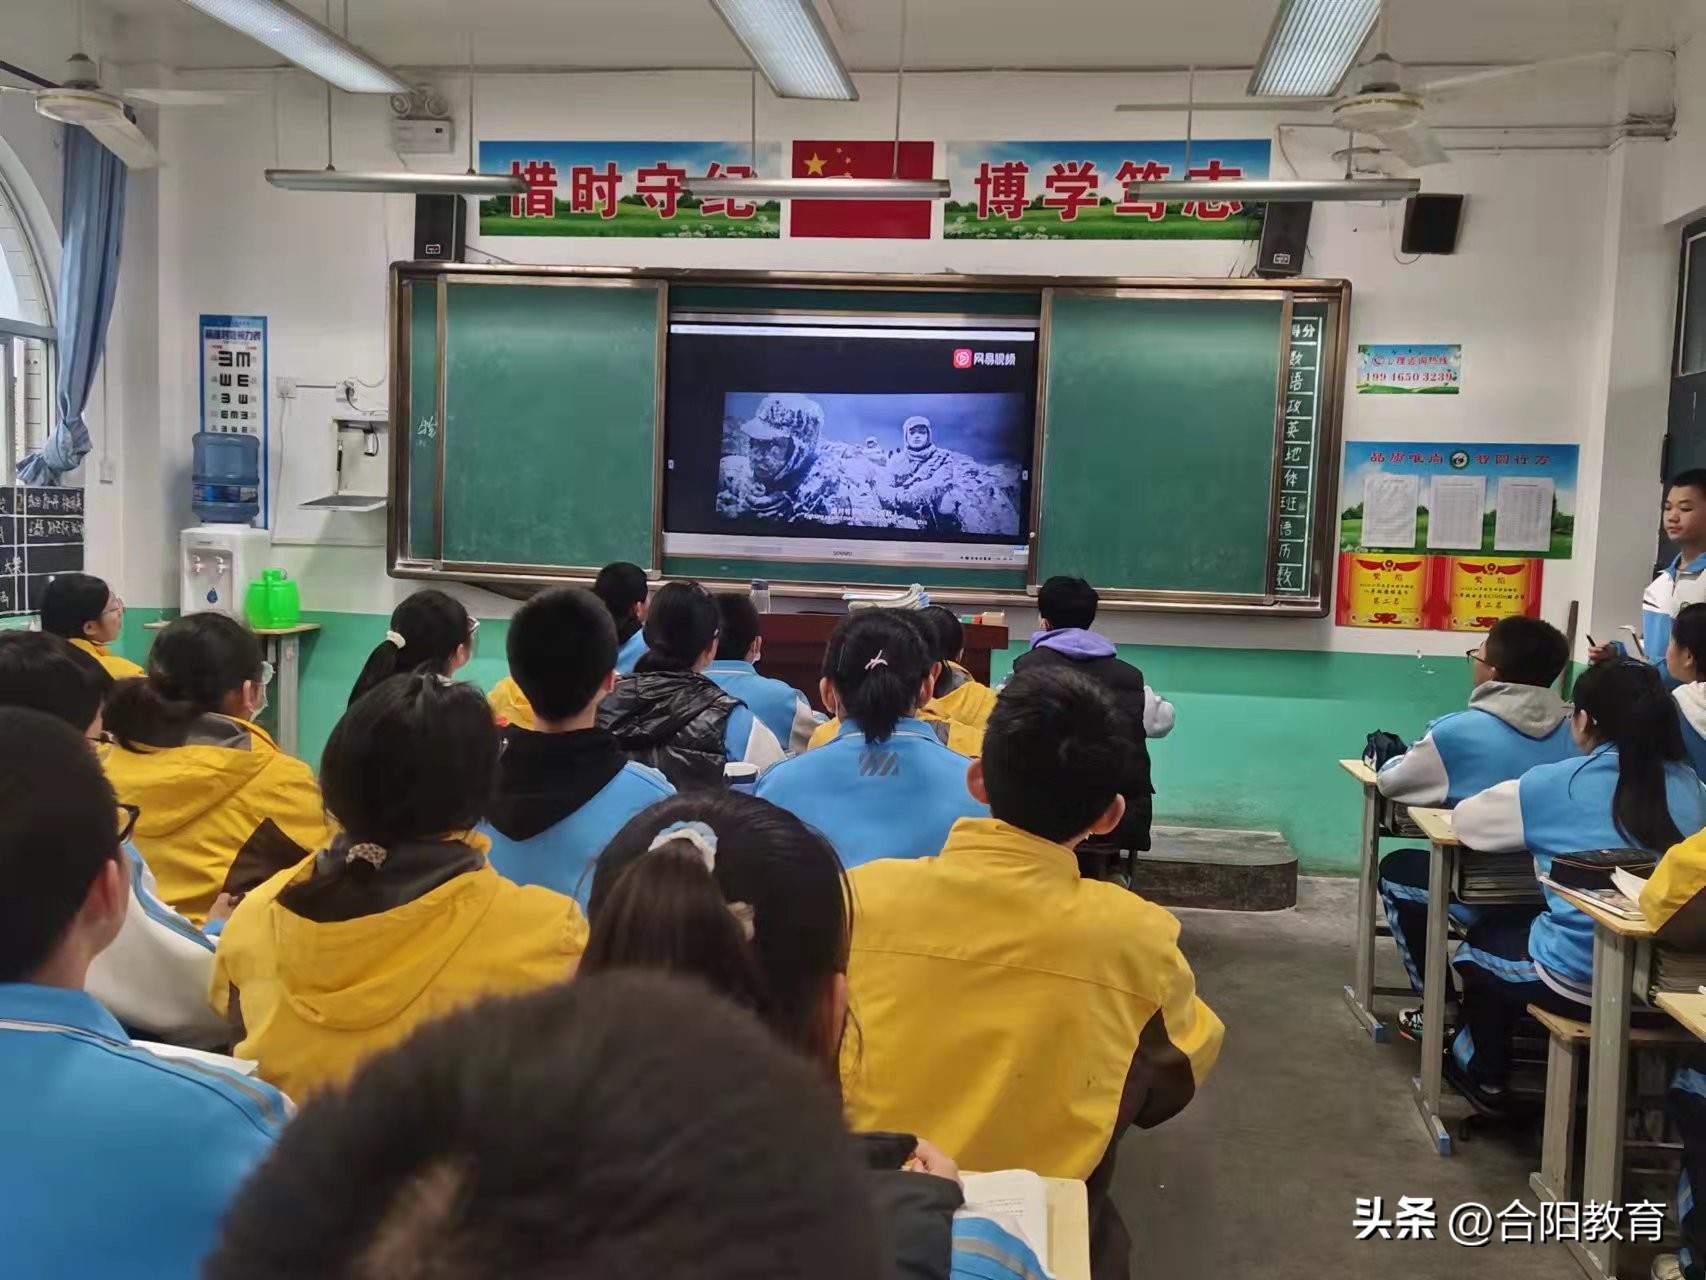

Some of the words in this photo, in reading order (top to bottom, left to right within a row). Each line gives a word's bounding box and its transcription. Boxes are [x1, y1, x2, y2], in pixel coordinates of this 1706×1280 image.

[510, 160, 757, 219] 惜时守纪
[974, 160, 1243, 220] 博学笃志
[973, 352, 1016, 366] 网易视频
[1366, 372, 1387, 382] 199
[1422, 372, 1453, 382] 3239
[1286, 399, 1302, 414] 政
[1286, 421, 1300, 439] 英
[1284, 447, 1302, 462] 地
[1284, 468, 1298, 488] 体
